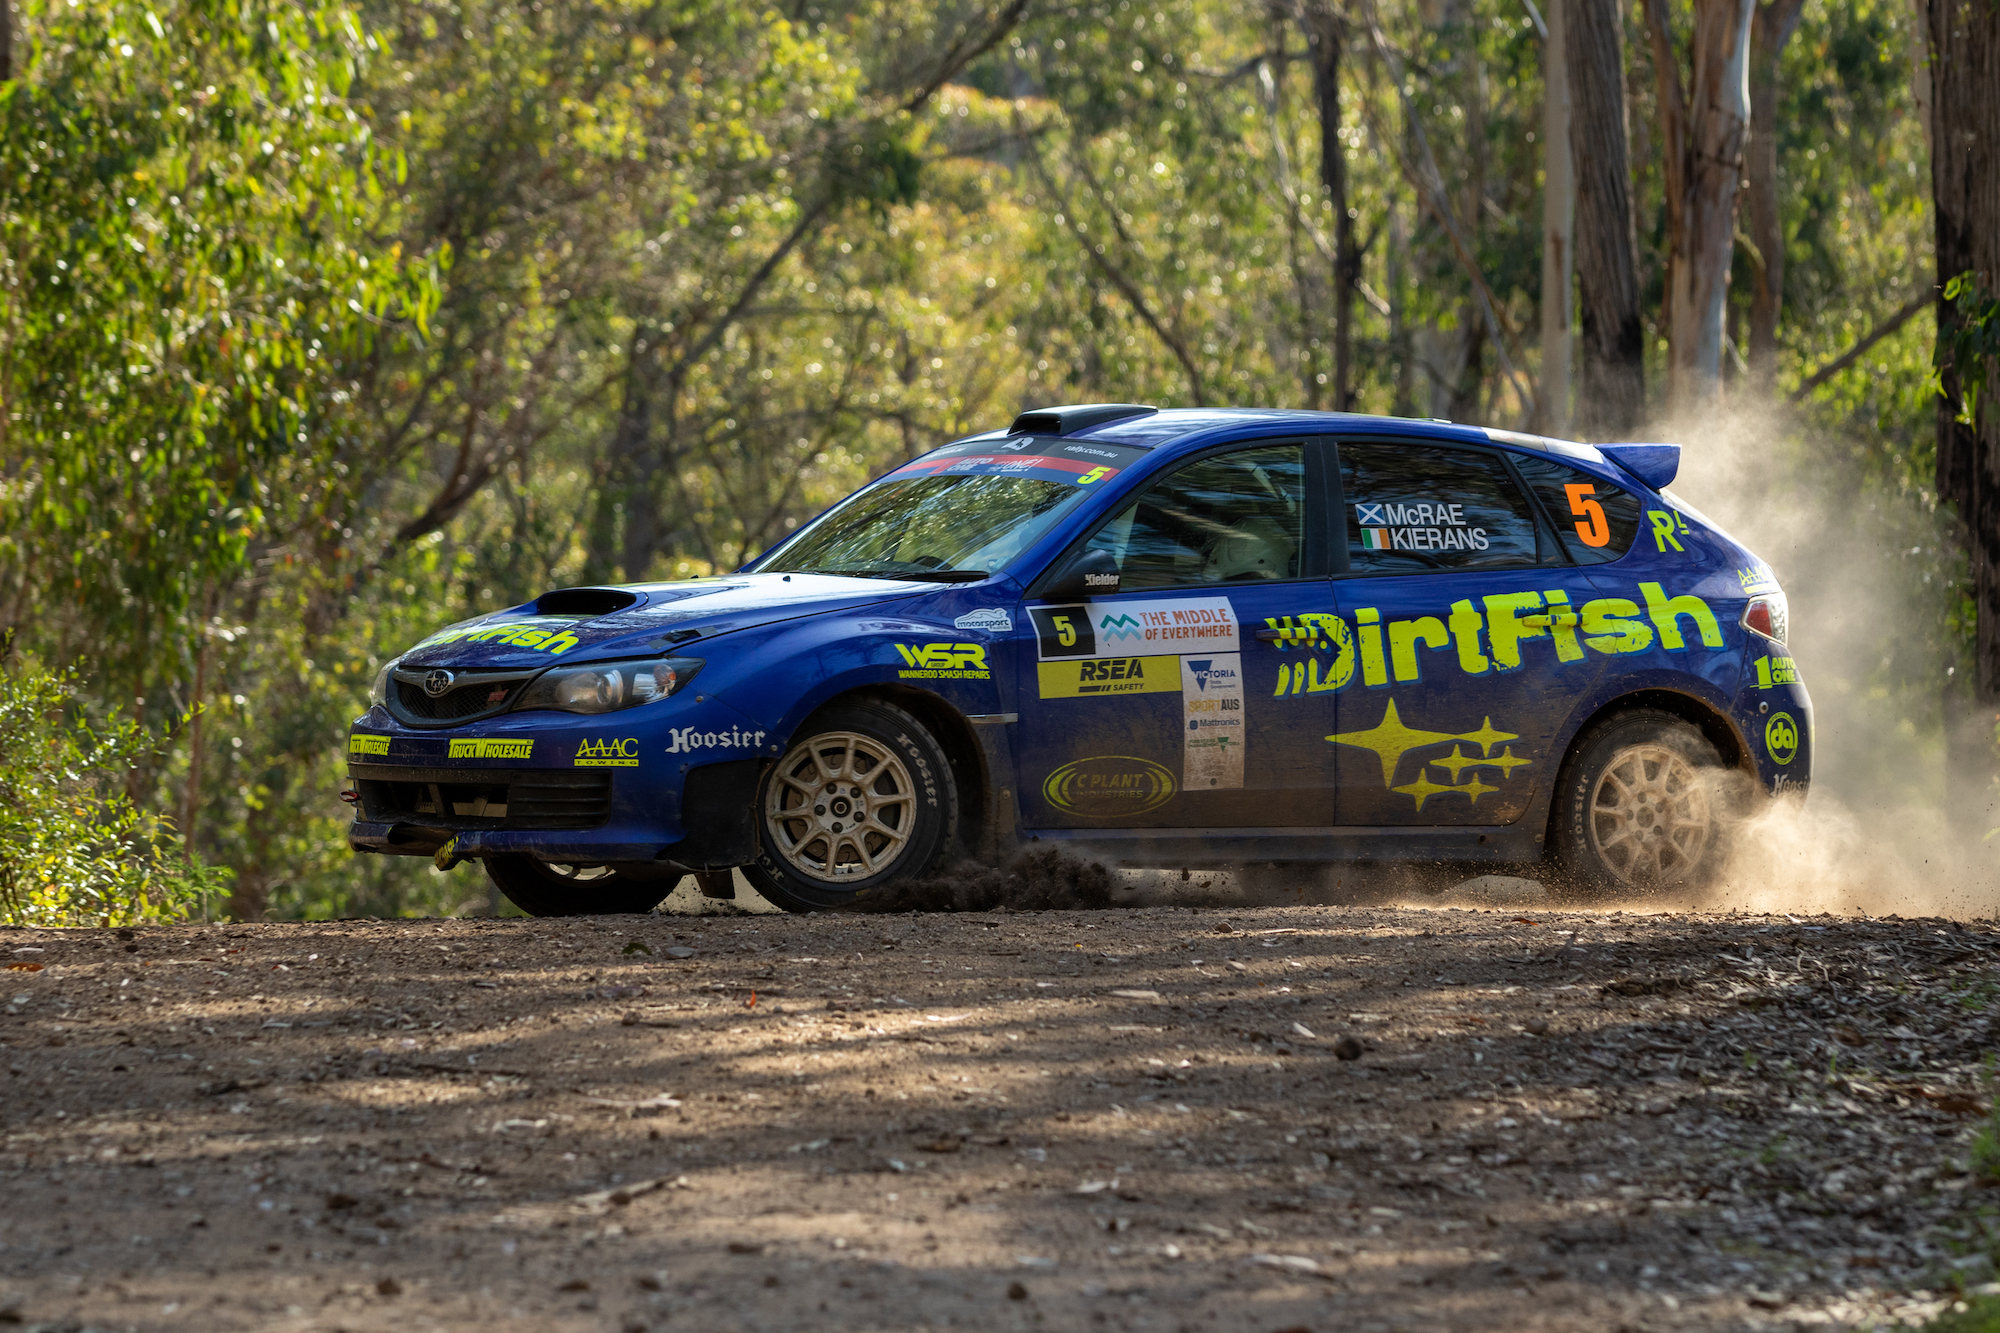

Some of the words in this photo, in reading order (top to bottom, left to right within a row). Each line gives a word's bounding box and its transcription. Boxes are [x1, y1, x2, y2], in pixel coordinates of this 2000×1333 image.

[1077, 466, 1111, 484] 5
[1385, 504, 1466, 525] McRAE
[1564, 484, 1610, 547] 5
[1391, 528, 1489, 550] KIERANS
[1084, 573, 1119, 586] Kielder
[957, 620, 1009, 630] motorsport
[1139, 611, 1170, 626] THE
[1172, 608, 1230, 624] MIDDLE
[1053, 616, 1077, 647] 5
[1145, 628, 1158, 641] OF
[1162, 624, 1233, 640] EVERYWHERE
[1264, 582, 1725, 697] DirtFish
[894, 643, 989, 669] WSR
[898, 670, 937, 679] WANNEROO
[938, 670, 962, 679] SMASH
[963, 670, 990, 679] REPAIRS
[1080, 659, 1144, 681] RSEA
[1194, 669, 1236, 679] VICTORIA
[1754, 655, 1772, 689] 1
[1772, 657, 1796, 670] AUTO
[1773, 669, 1796, 682] ONE
[1113, 683, 1144, 691] SAFETY
[1200, 718, 1241, 726] Mattronics
[575, 738, 639, 757] AAAC
[664, 724, 766, 754] Hoosier
[1077, 774, 1088, 788] C
[1090, 773, 1144, 788] PLANT
[1076, 790, 1144, 798] INDUSTRIES
